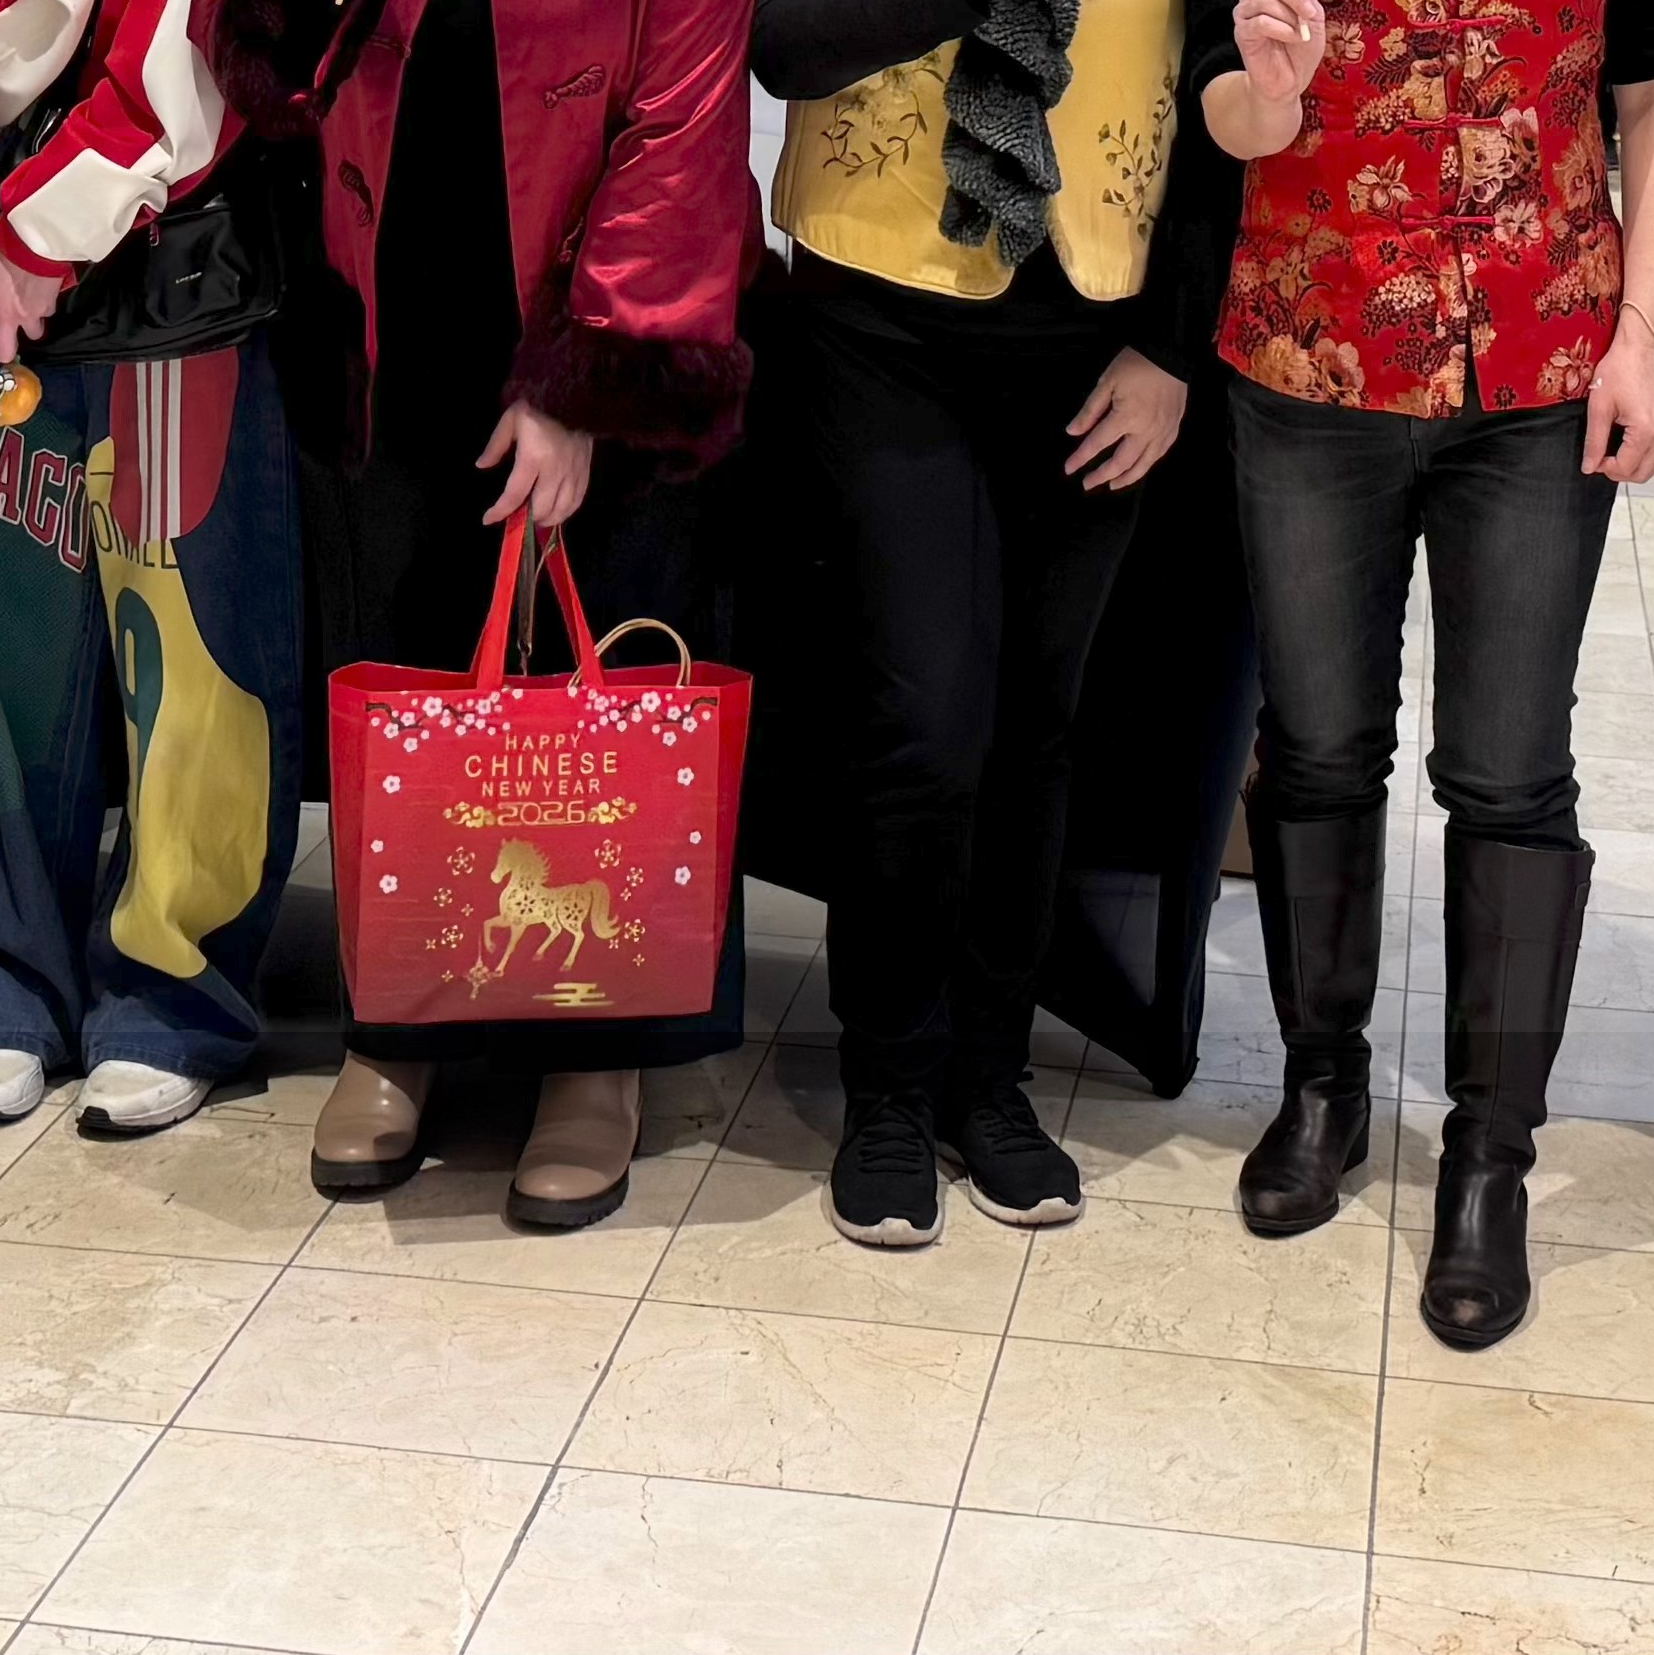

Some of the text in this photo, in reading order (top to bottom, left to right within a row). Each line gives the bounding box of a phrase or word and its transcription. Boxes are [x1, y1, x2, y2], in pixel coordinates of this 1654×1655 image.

[504, 732, 581, 751] HAPPY
[464, 751, 618, 778] CHINESE
[481, 778, 601, 797] NEW YEAR
[497, 800, 586, 827] 2026
